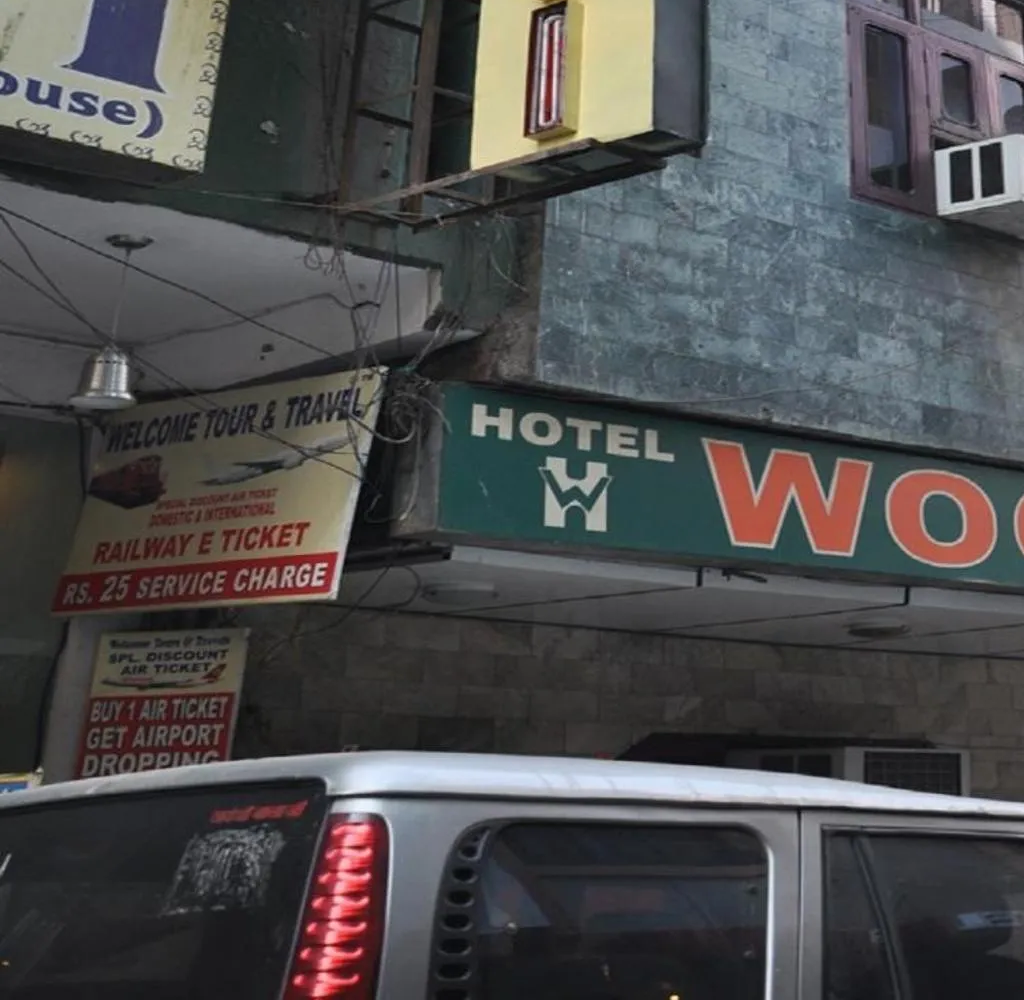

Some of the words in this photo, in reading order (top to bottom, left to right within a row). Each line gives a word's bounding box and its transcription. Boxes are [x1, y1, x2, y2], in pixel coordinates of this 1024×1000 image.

[106, 412, 198, 453] WELCOME
[204, 403, 259, 439] TOUR
[261, 400, 277, 430] &
[284, 386, 364, 429] TRAVEL
[470, 402, 675, 463] HOTEL
[247, 488, 278, 499] TICKET
[149, 510, 192, 527] DOMESTIC
[203, 503, 276, 523] INTERNATIONAL
[93, 534, 195, 564] RAILWAY
[197, 531, 215, 555] E
[222, 522, 310, 552] TICKET
[62, 581, 93, 606] RS.
[100, 574, 132, 602] 25
[136, 570, 232, 600] SERVICE
[233, 562, 329, 592] CHARGE
[121, 664, 148, 675] AIR
[154, 662, 211, 674] TICKET
[146, 649, 229, 662] DISCOUNT
[90, 700, 122, 722] BUY
[126, 700, 134, 721] 1
[139, 698, 168, 721] AIR
[171, 696, 229, 719] TICKET
[86, 726, 128, 749] GET
[132, 724, 224, 748] AIRPORT
[81, 750, 220, 776] DROPPING
